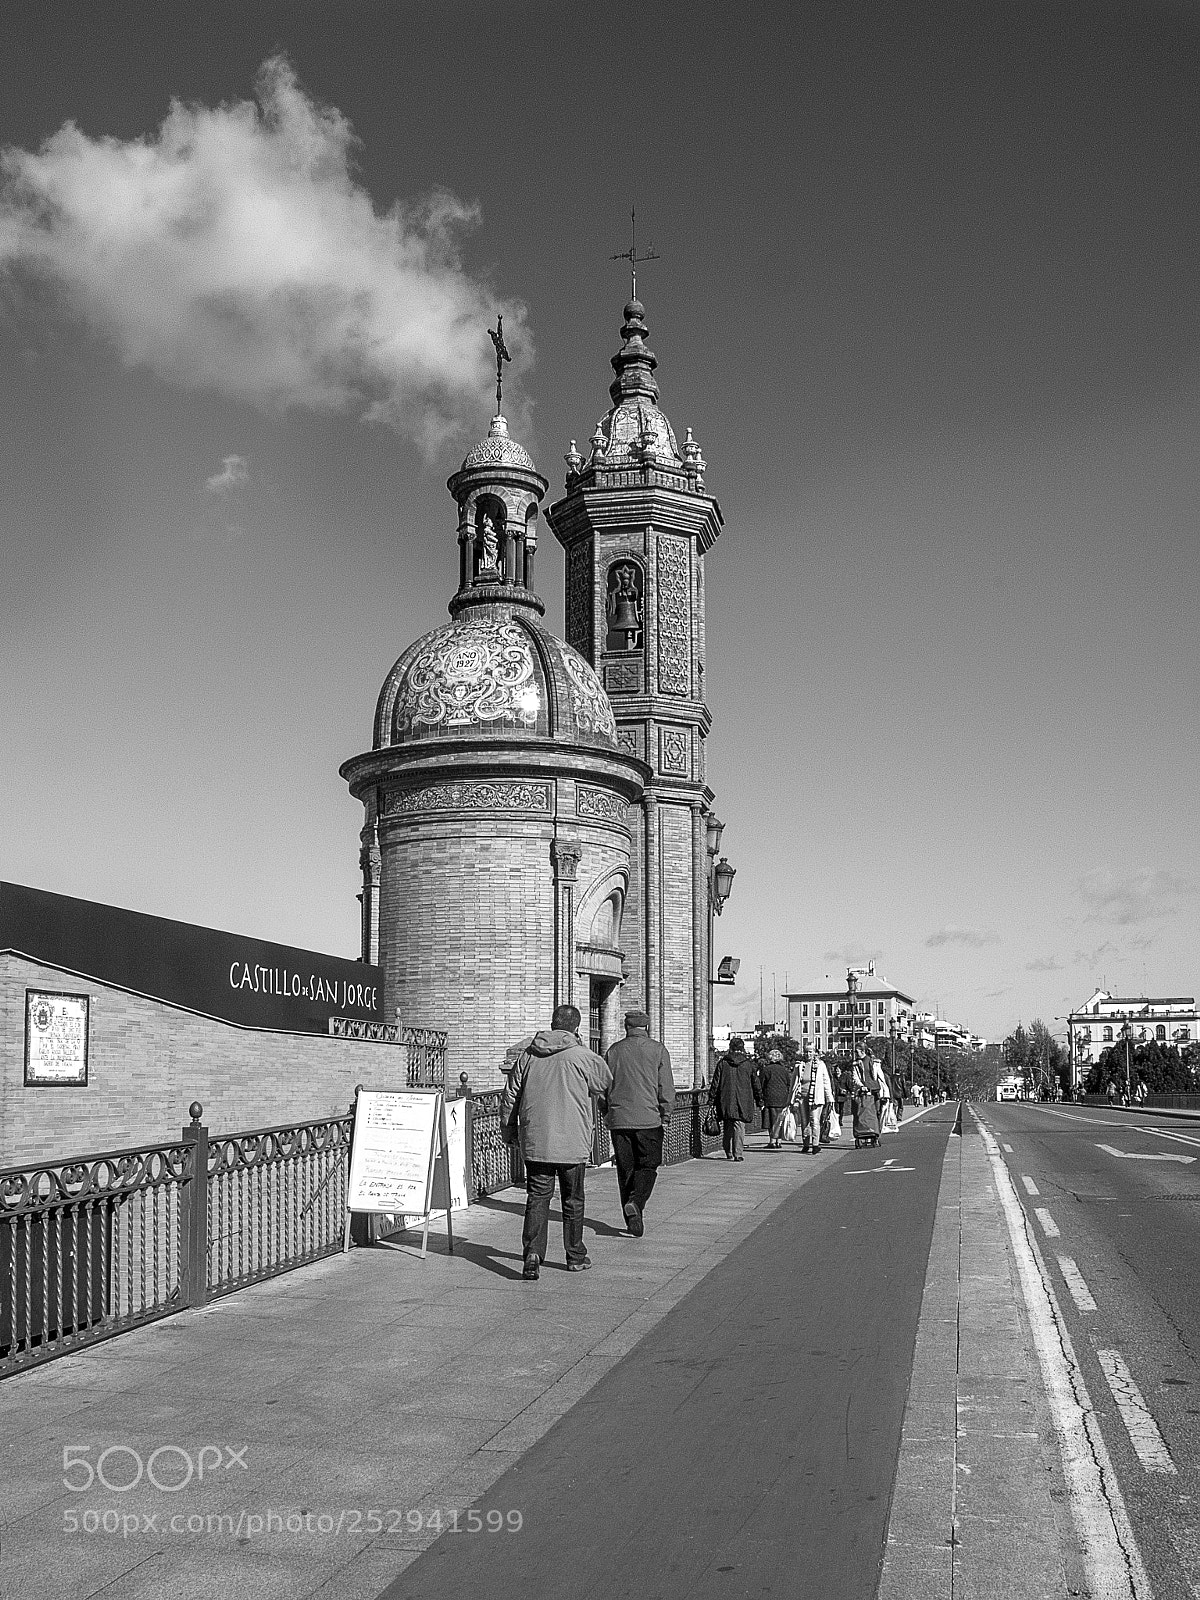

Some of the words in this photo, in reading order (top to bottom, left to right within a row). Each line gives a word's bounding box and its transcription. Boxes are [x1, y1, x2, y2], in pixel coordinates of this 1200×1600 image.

[456, 659, 475, 668] 1927
[229, 961, 301, 997] CASTILLO
[302, 986, 309, 997] DE
[309, 974, 338, 1004] SAN
[341, 980, 378, 1011] JORGE
